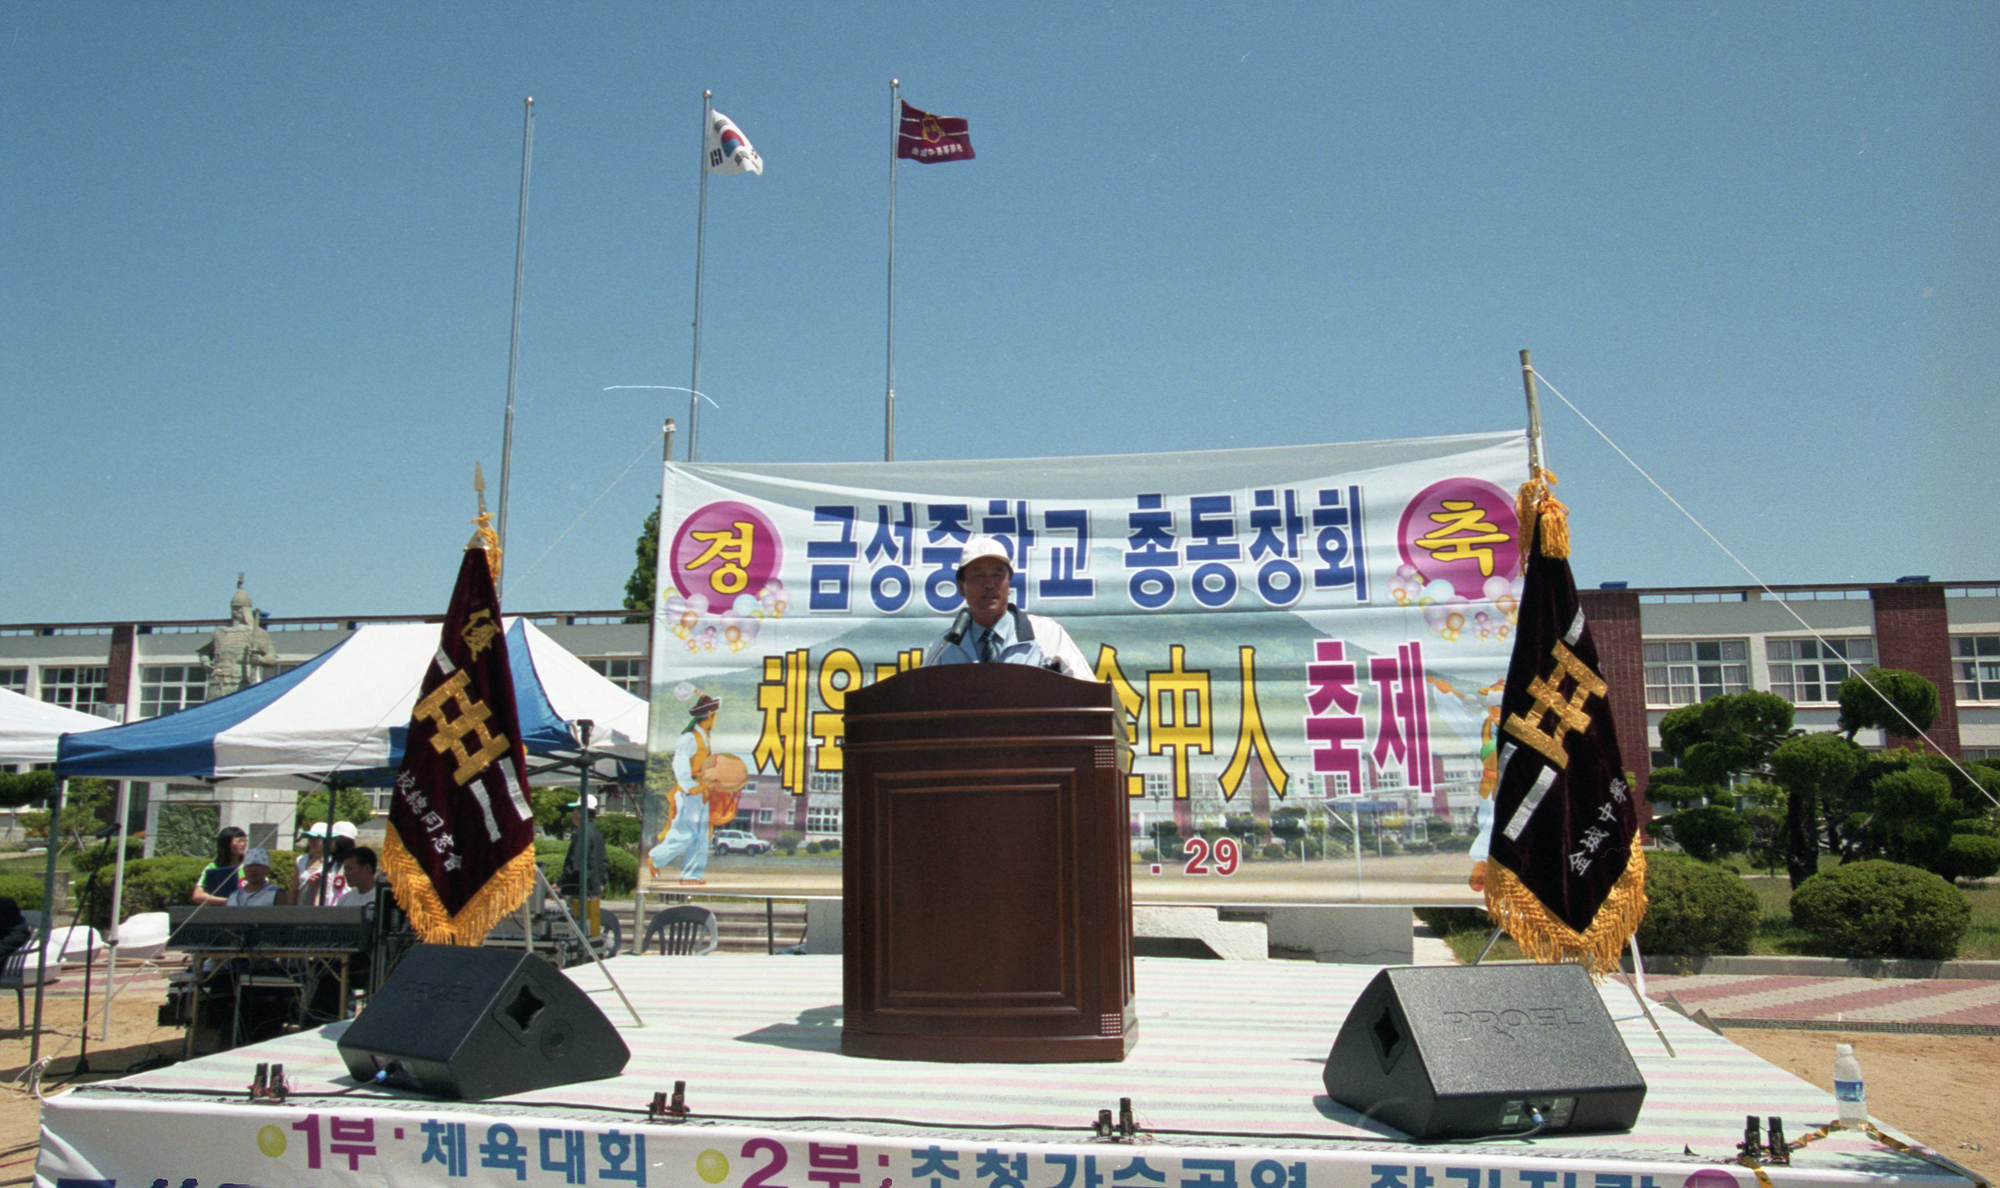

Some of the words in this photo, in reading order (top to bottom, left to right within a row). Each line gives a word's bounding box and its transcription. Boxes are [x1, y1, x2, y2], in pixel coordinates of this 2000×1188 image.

[685, 522, 755, 595] 경
[806, 499, 1095, 612] 금성중학교
[1124, 484, 1369, 608] 총동창회
[1414, 500, 1511, 578] 축
[1305, 640, 1434, 795] 축제
[420, 1118, 648, 1188] 체육대회
